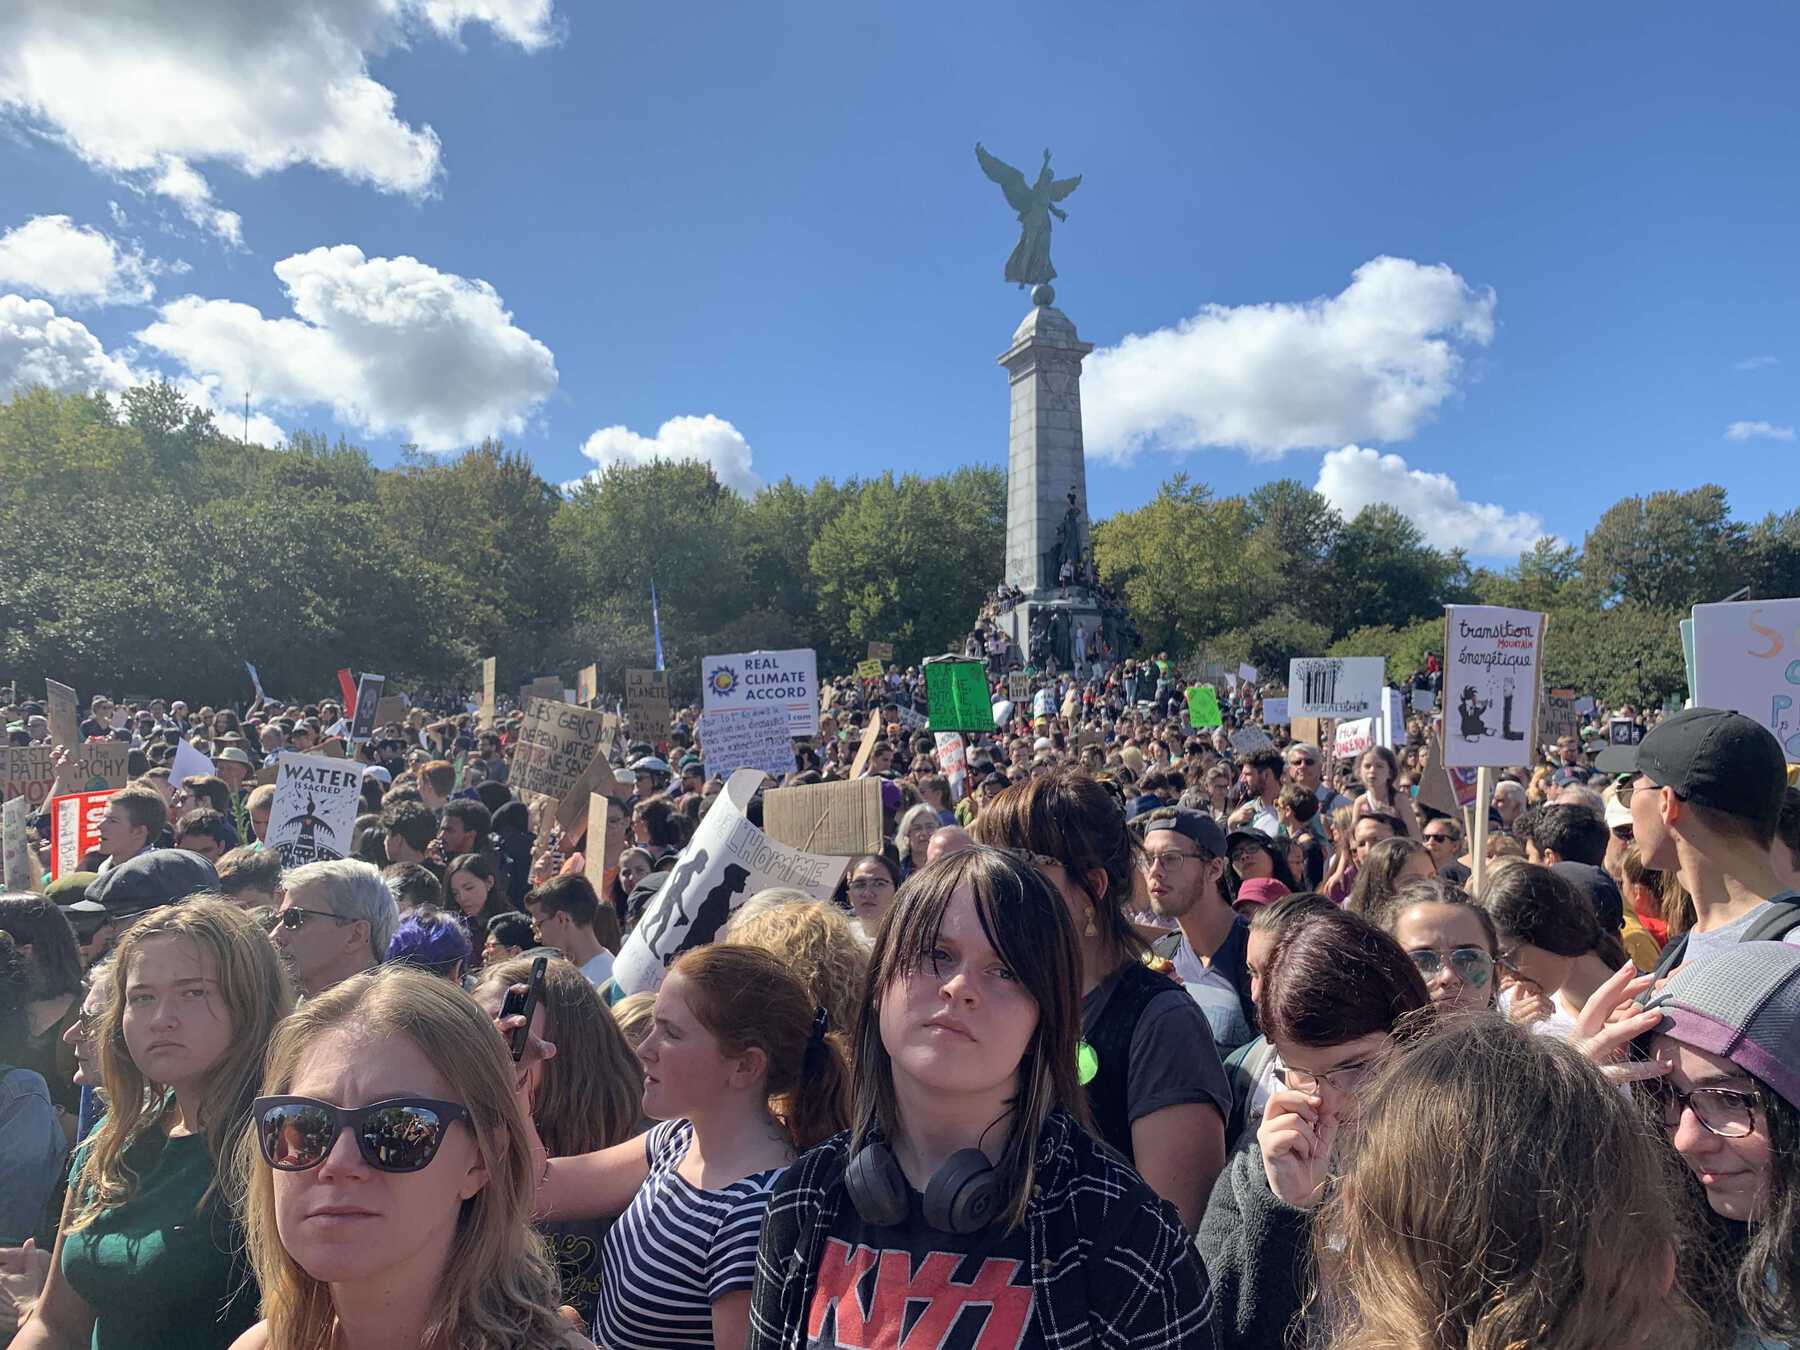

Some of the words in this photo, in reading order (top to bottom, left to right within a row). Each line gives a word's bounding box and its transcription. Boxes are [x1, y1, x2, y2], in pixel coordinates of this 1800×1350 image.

[745, 658, 779, 670] REAL
[1458, 645, 1532, 674] énergétique
[745, 672, 805, 685] CLIMATE
[746, 687, 807, 701] ACCORD
[528, 702, 556, 720] LES
[558, 711, 593, 740] GENS
[10, 748, 47, 763] DEST
[285, 763, 357, 788] WATER
[295, 781, 302, 790] IS
[304, 783, 341, 795] SACRED
[806, 1237, 1035, 1350] KISS
